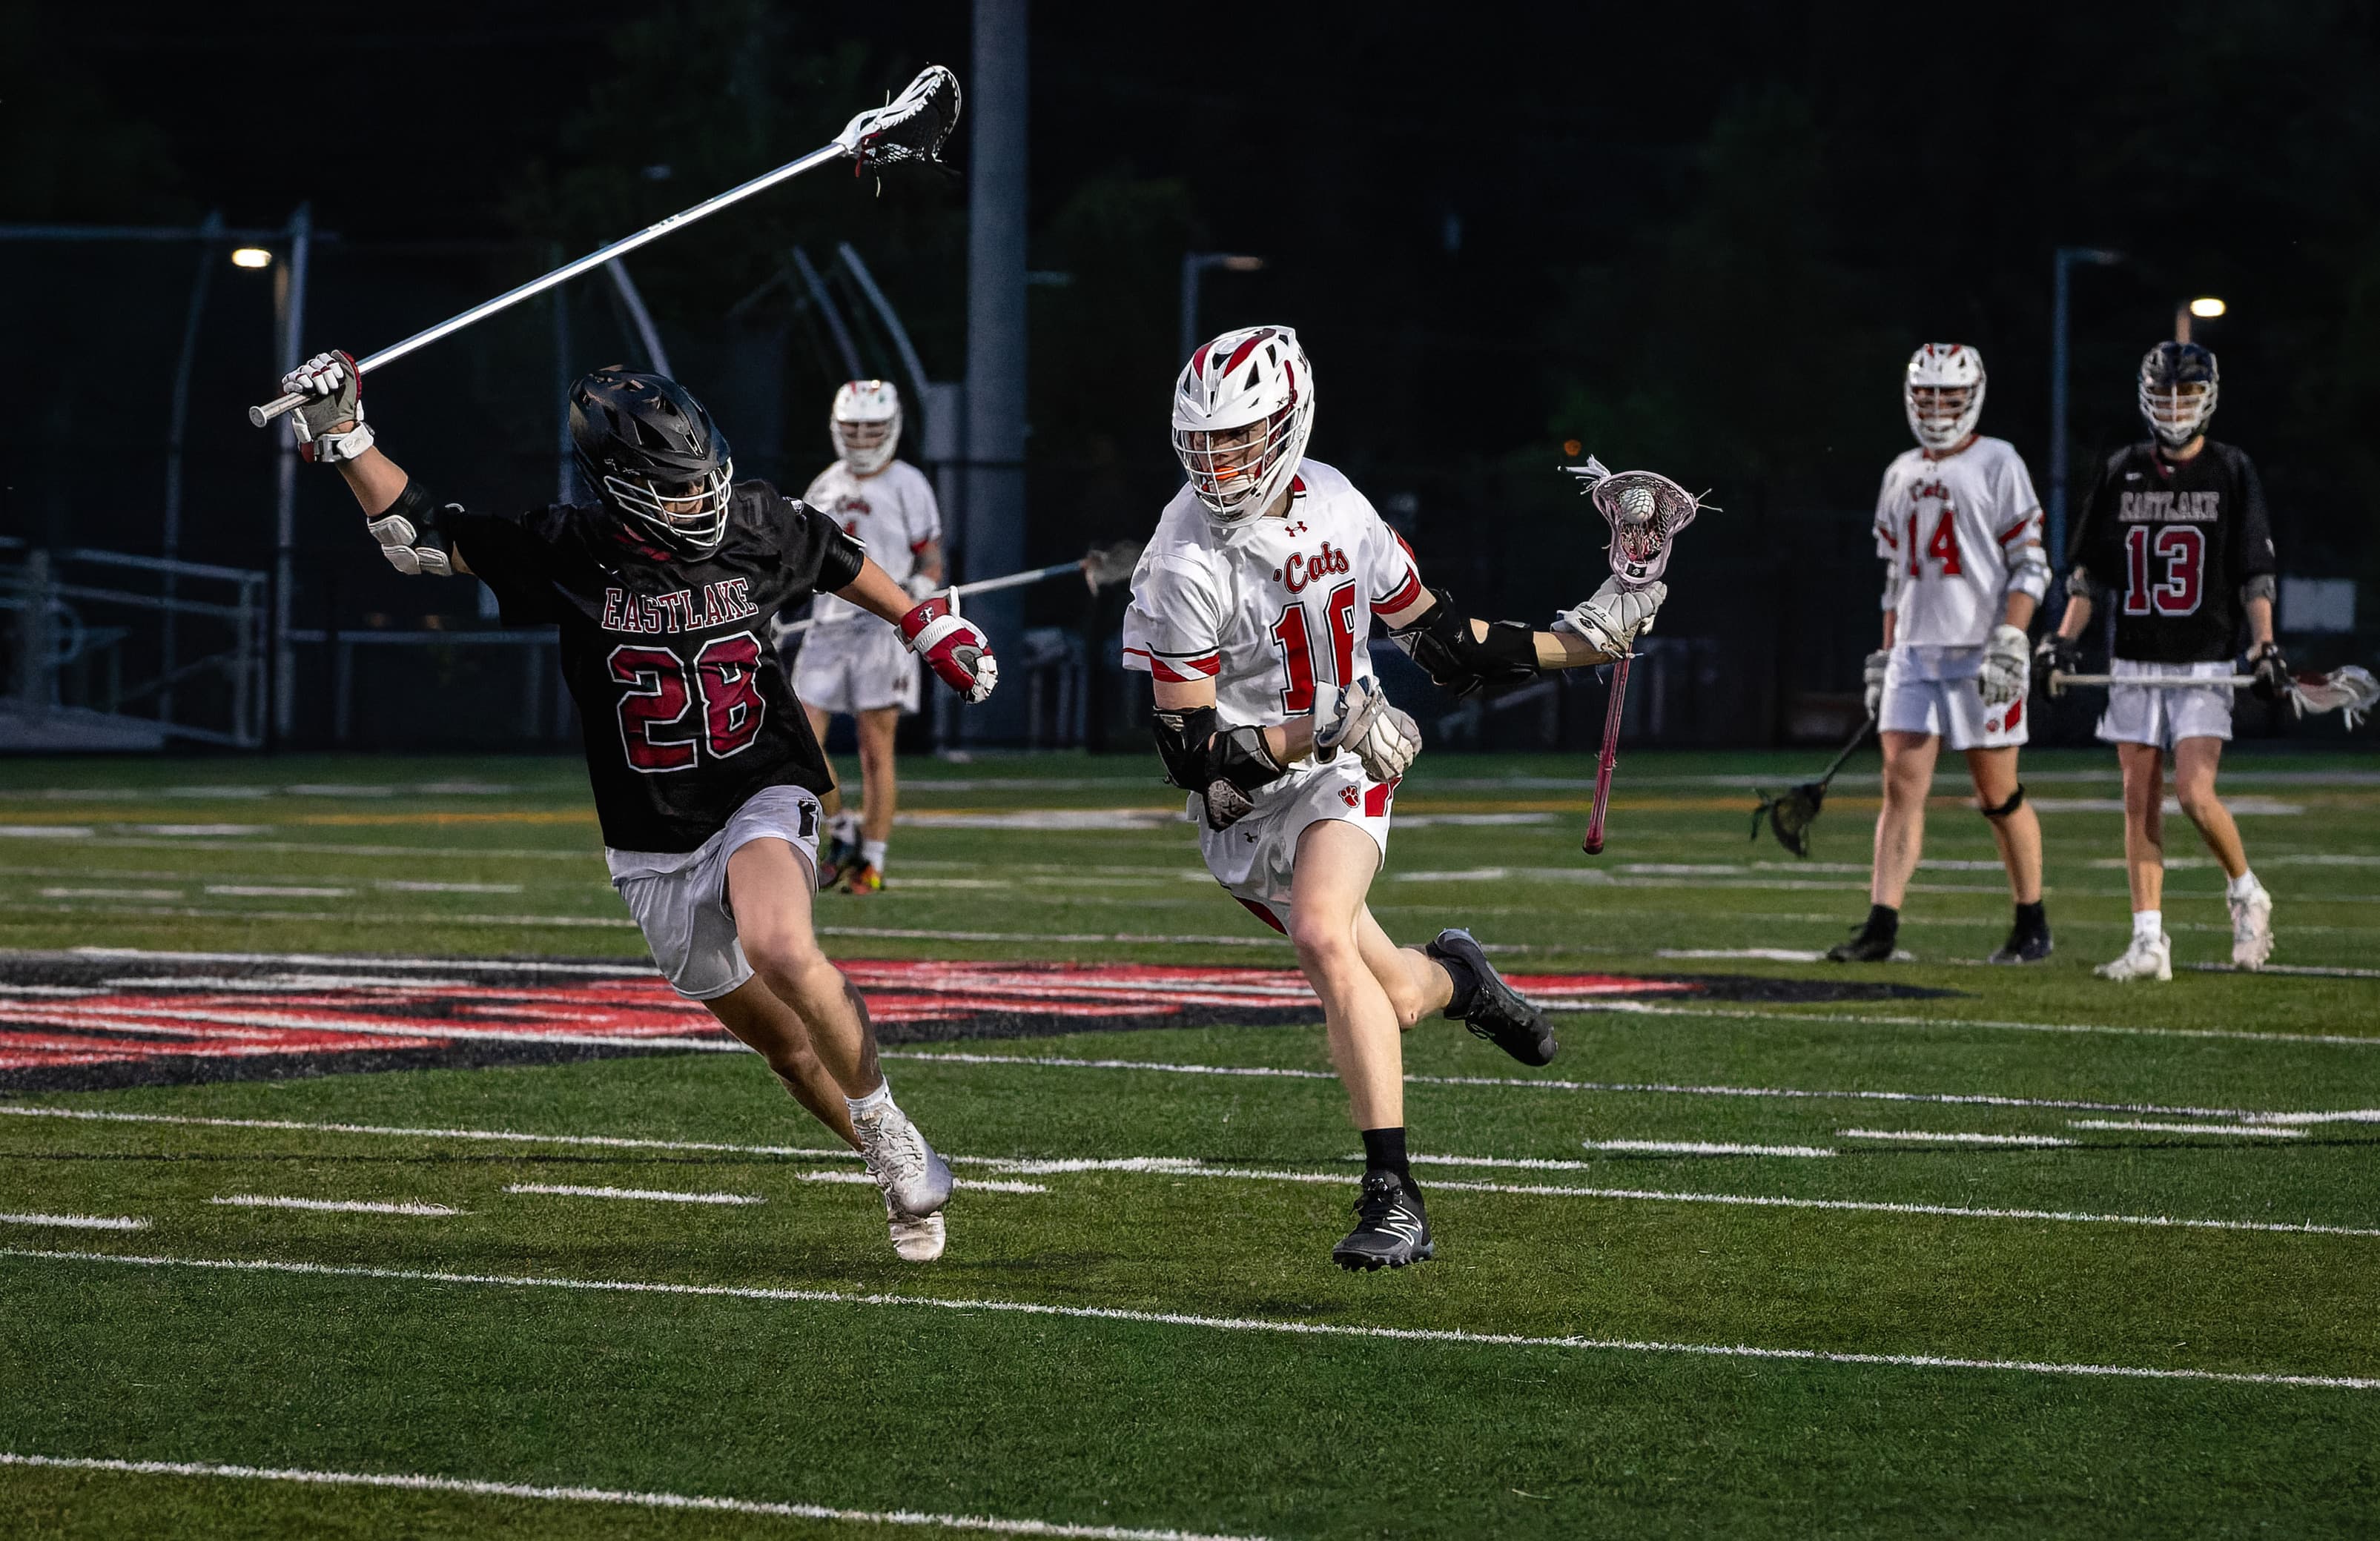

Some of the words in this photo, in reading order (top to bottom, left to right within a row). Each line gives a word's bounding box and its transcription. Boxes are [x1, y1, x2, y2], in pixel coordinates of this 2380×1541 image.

[1907, 510, 1962, 577] 14
[2124, 525, 2205, 615] 13
[601, 577, 758, 634] EASTLAKE
[607, 630, 766, 773] 28
